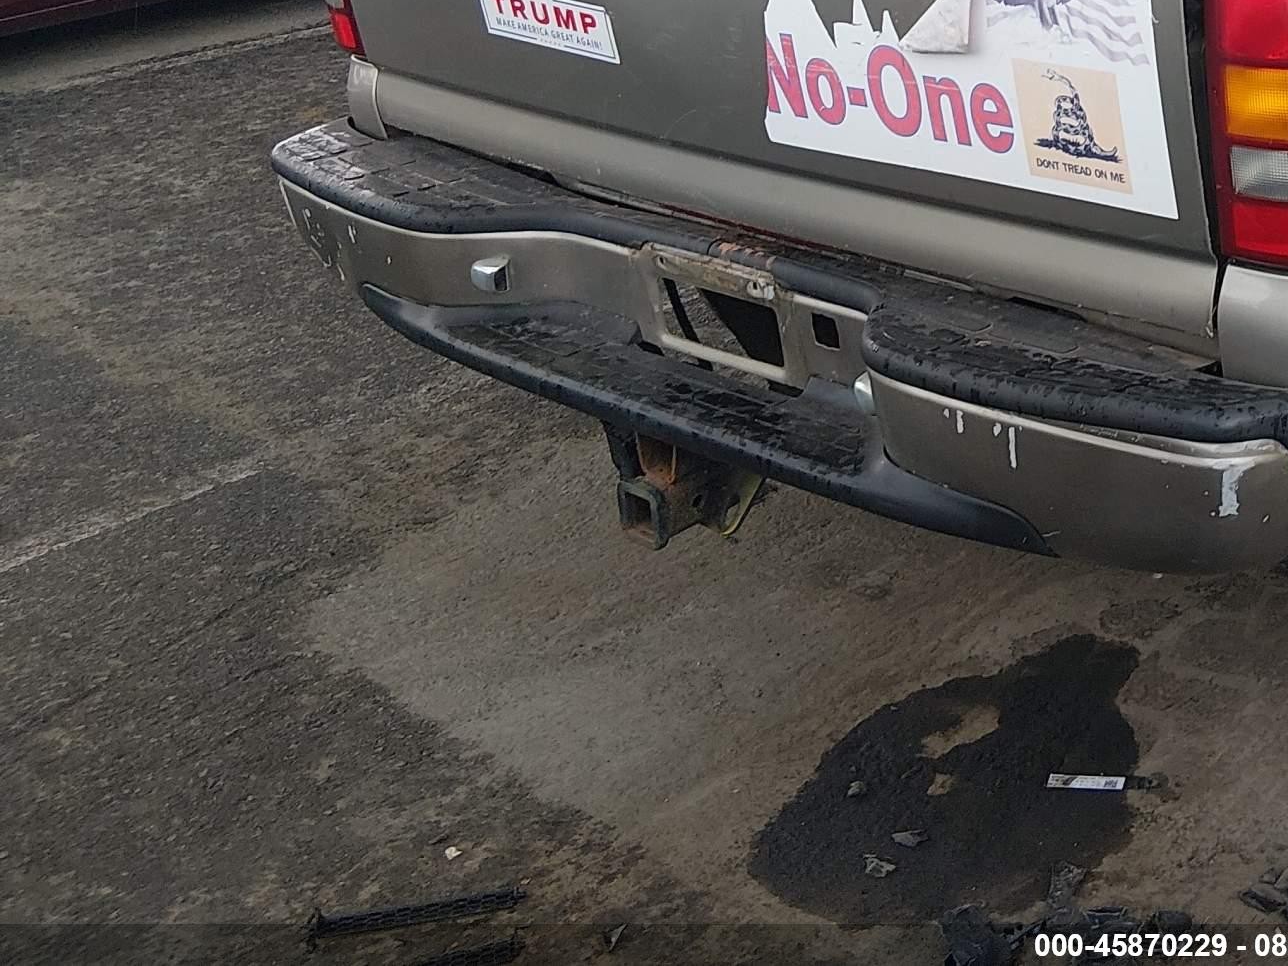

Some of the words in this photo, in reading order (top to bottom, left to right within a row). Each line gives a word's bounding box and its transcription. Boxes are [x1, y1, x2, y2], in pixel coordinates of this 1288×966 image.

[496, 16, 517, 30] MAKE
[517, 22, 549, 38] AMERICA
[551, 30, 574, 44] GREAT
[576, 36, 603, 51] AGAIN!
[765, 33, 1015, 154] No-One
[1036, 157, 1060, 171] DONT
[1061, 162, 1092, 177] TREAD
[1094, 168, 1108, 180] ON
[1109, 172, 1127, 183] ME
